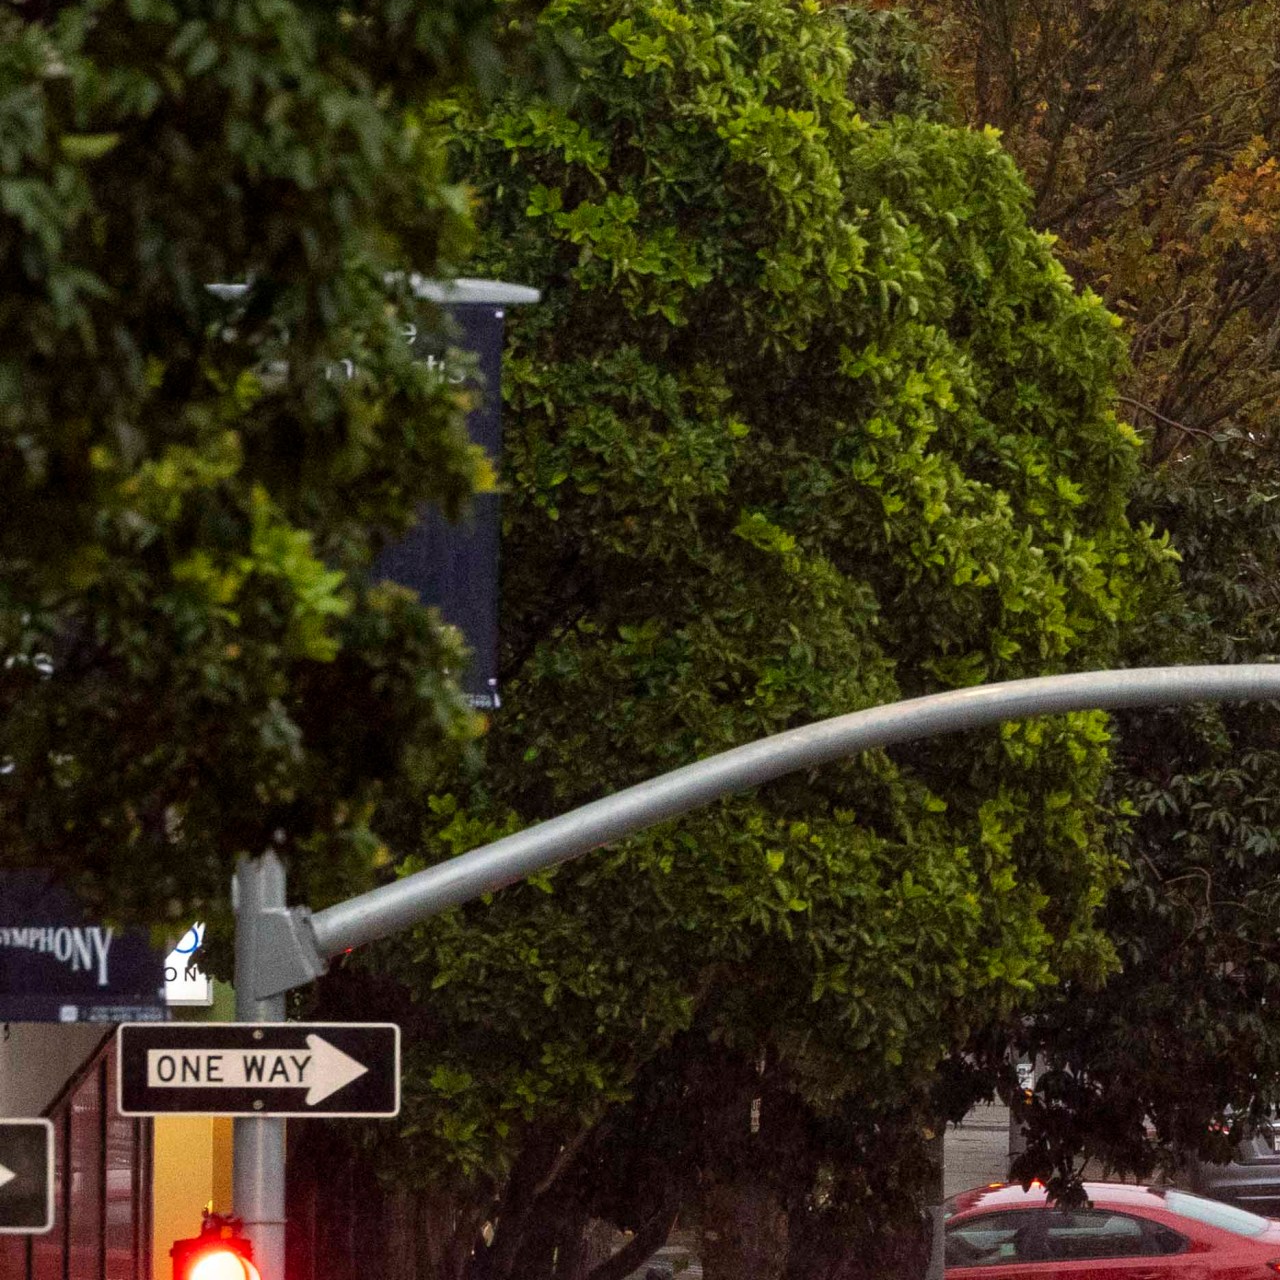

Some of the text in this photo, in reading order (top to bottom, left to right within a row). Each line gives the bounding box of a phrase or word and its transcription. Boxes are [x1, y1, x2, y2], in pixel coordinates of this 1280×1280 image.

[0, 926, 113, 987] YMPHONY
[157, 1055, 312, 1083] ONE WAY
